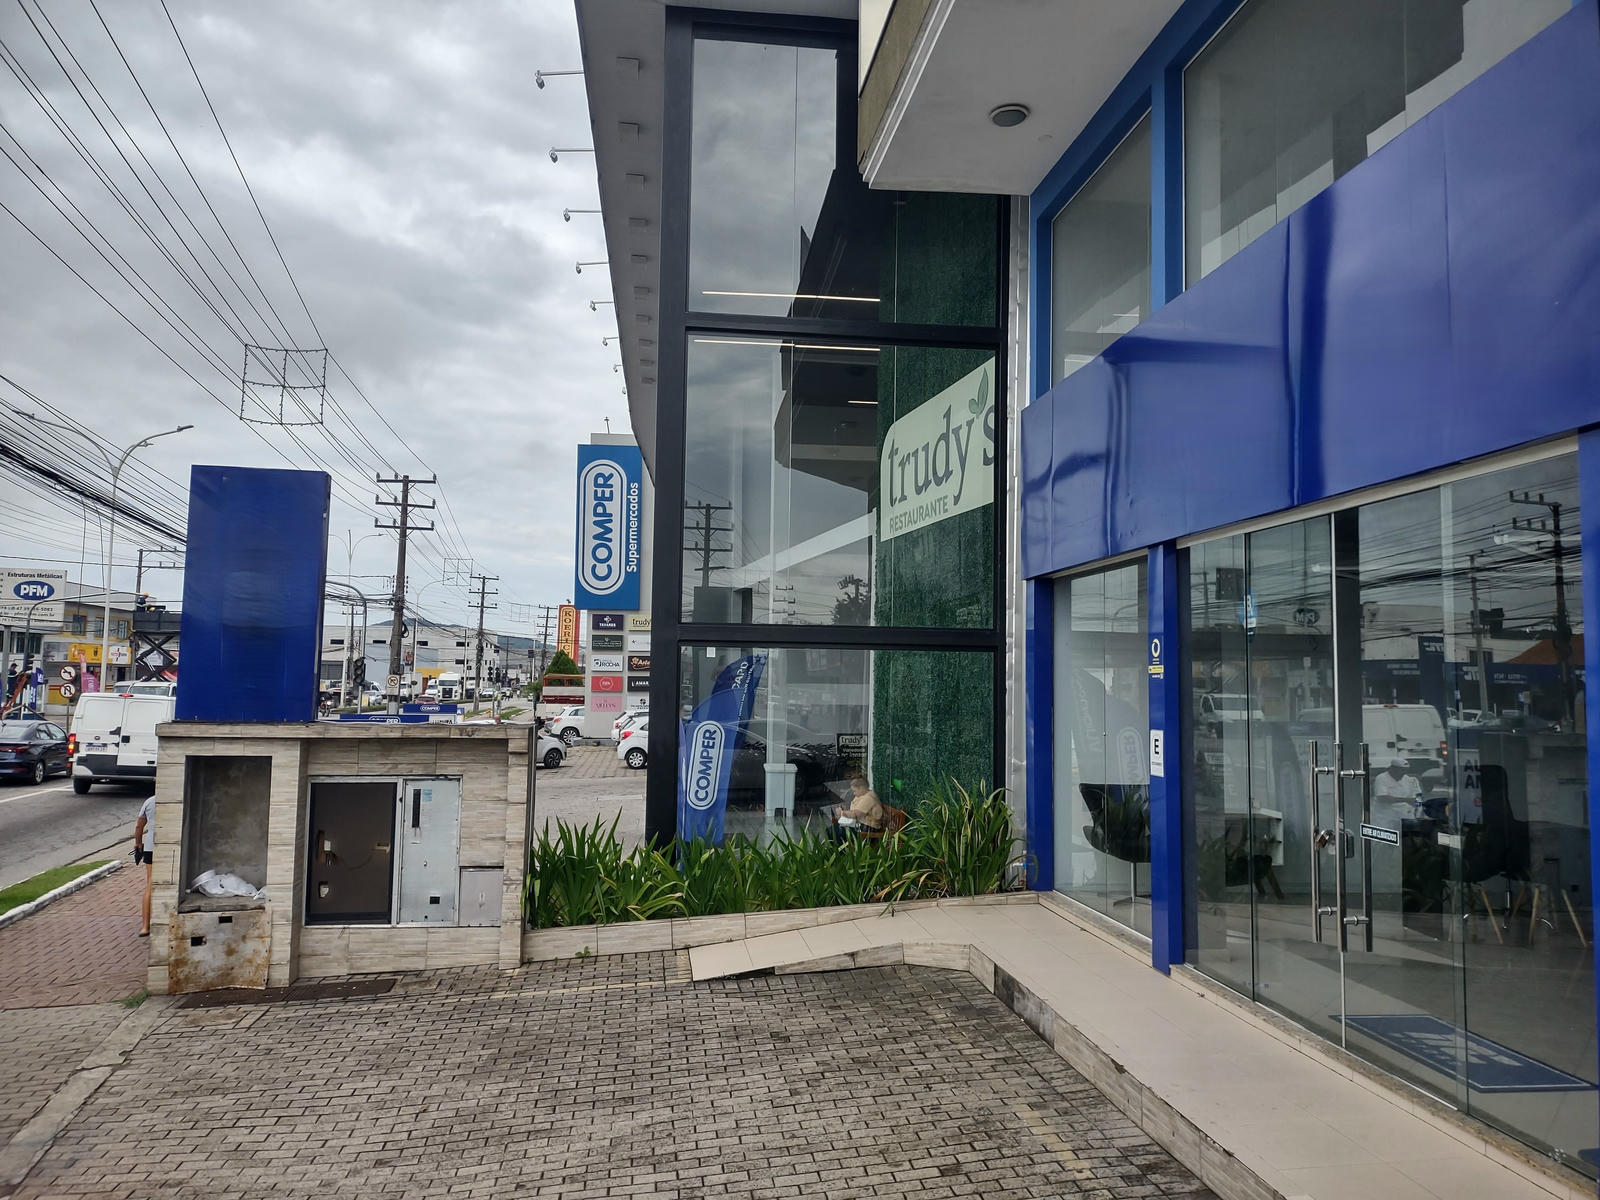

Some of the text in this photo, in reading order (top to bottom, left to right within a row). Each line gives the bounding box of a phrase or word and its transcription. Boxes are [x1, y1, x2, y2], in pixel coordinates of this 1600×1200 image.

[591, 472, 615, 582] COMPER
[626, 482, 639, 573] Supermercados
[889, 495, 949, 534] RESTAURANTE
[20, 584, 48, 597] PFM
[694, 728, 717, 802] COMPER
